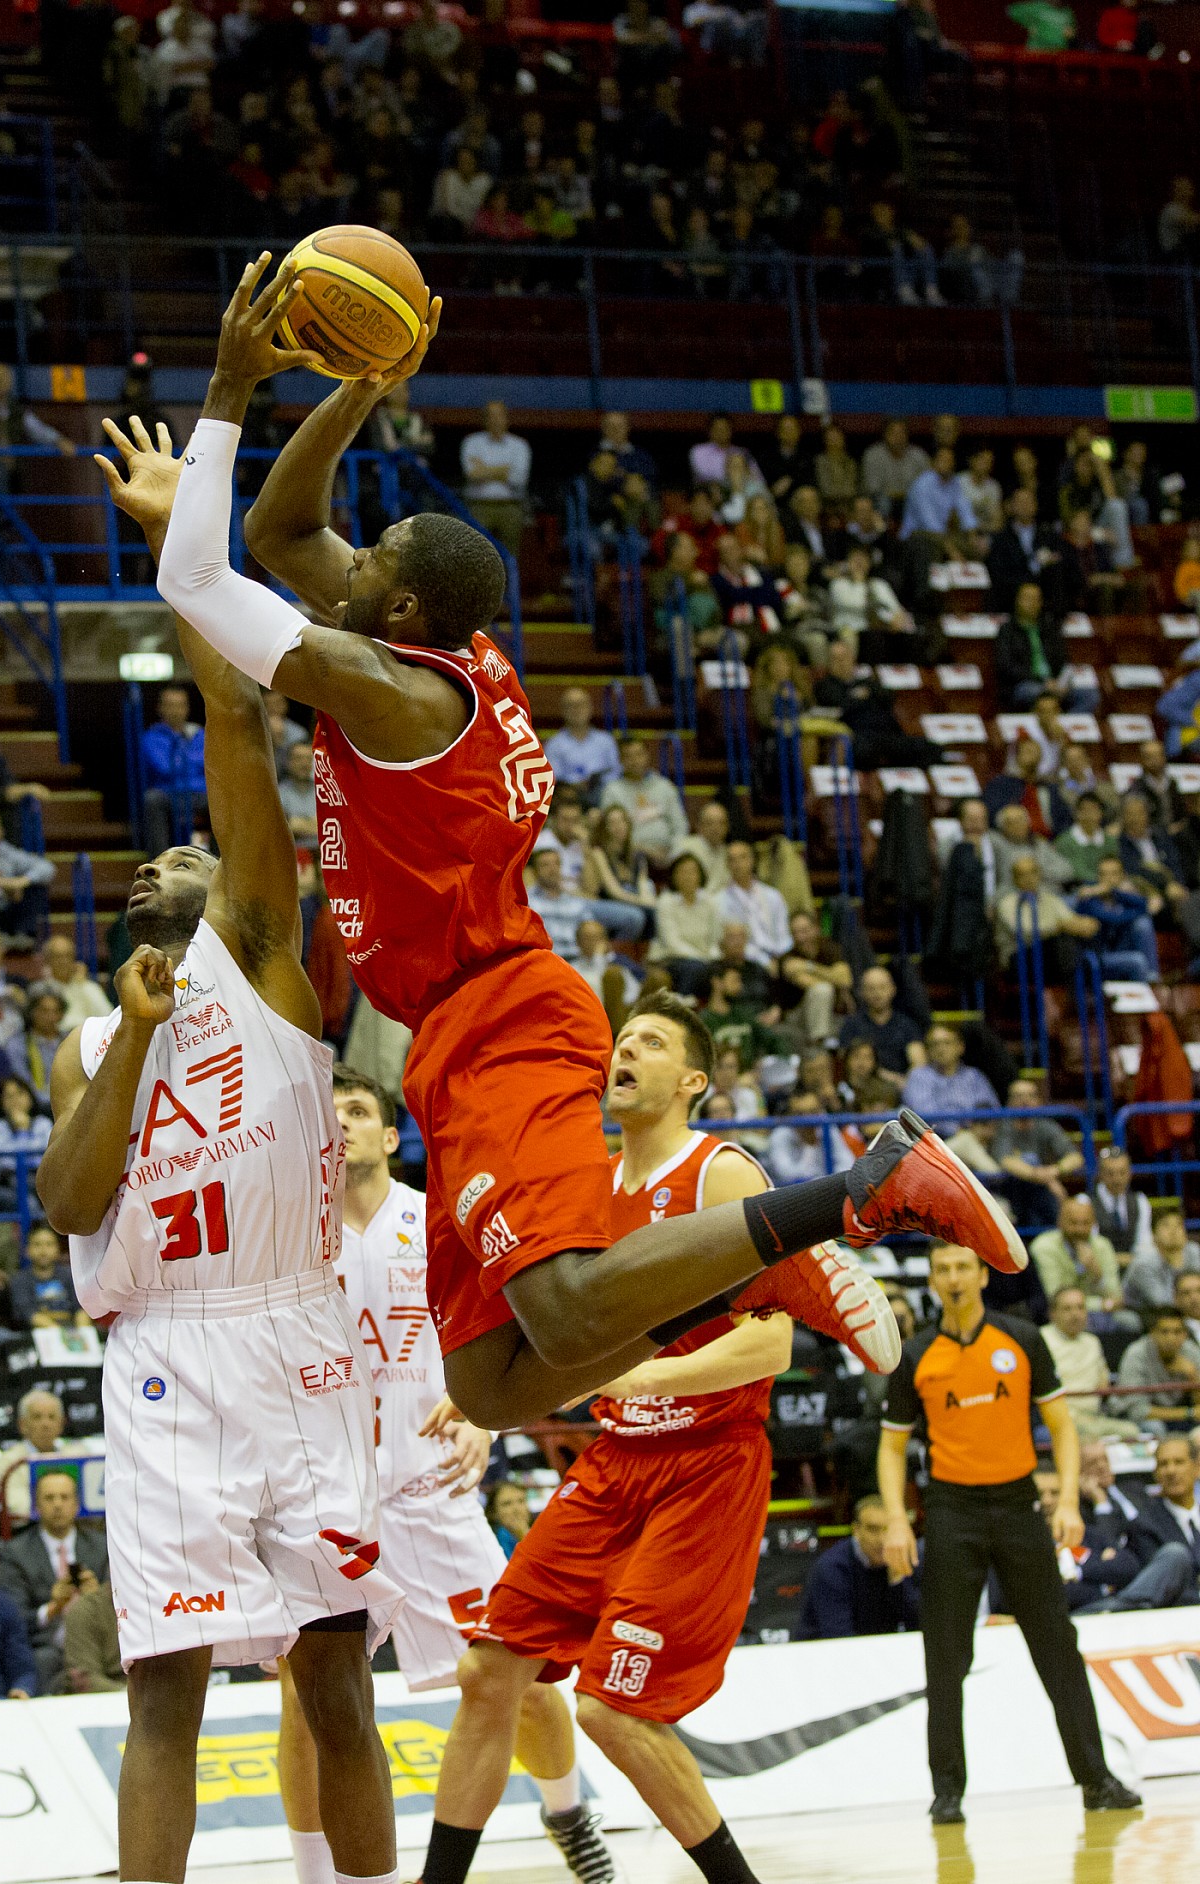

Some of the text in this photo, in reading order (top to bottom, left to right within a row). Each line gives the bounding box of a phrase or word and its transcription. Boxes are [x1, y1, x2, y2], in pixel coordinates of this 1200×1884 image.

[321, 284, 403, 350] molten
[320, 817, 348, 870] 2
[176, 1017, 235, 1053] EYEWEAR
[121, 1043, 244, 1180] A7
[126, 1120, 277, 1192] ORIO ARMANI
[149, 1180, 230, 1262] 31
[298, 1355, 354, 1390] EA7
[602, 1648, 651, 1697] 13
